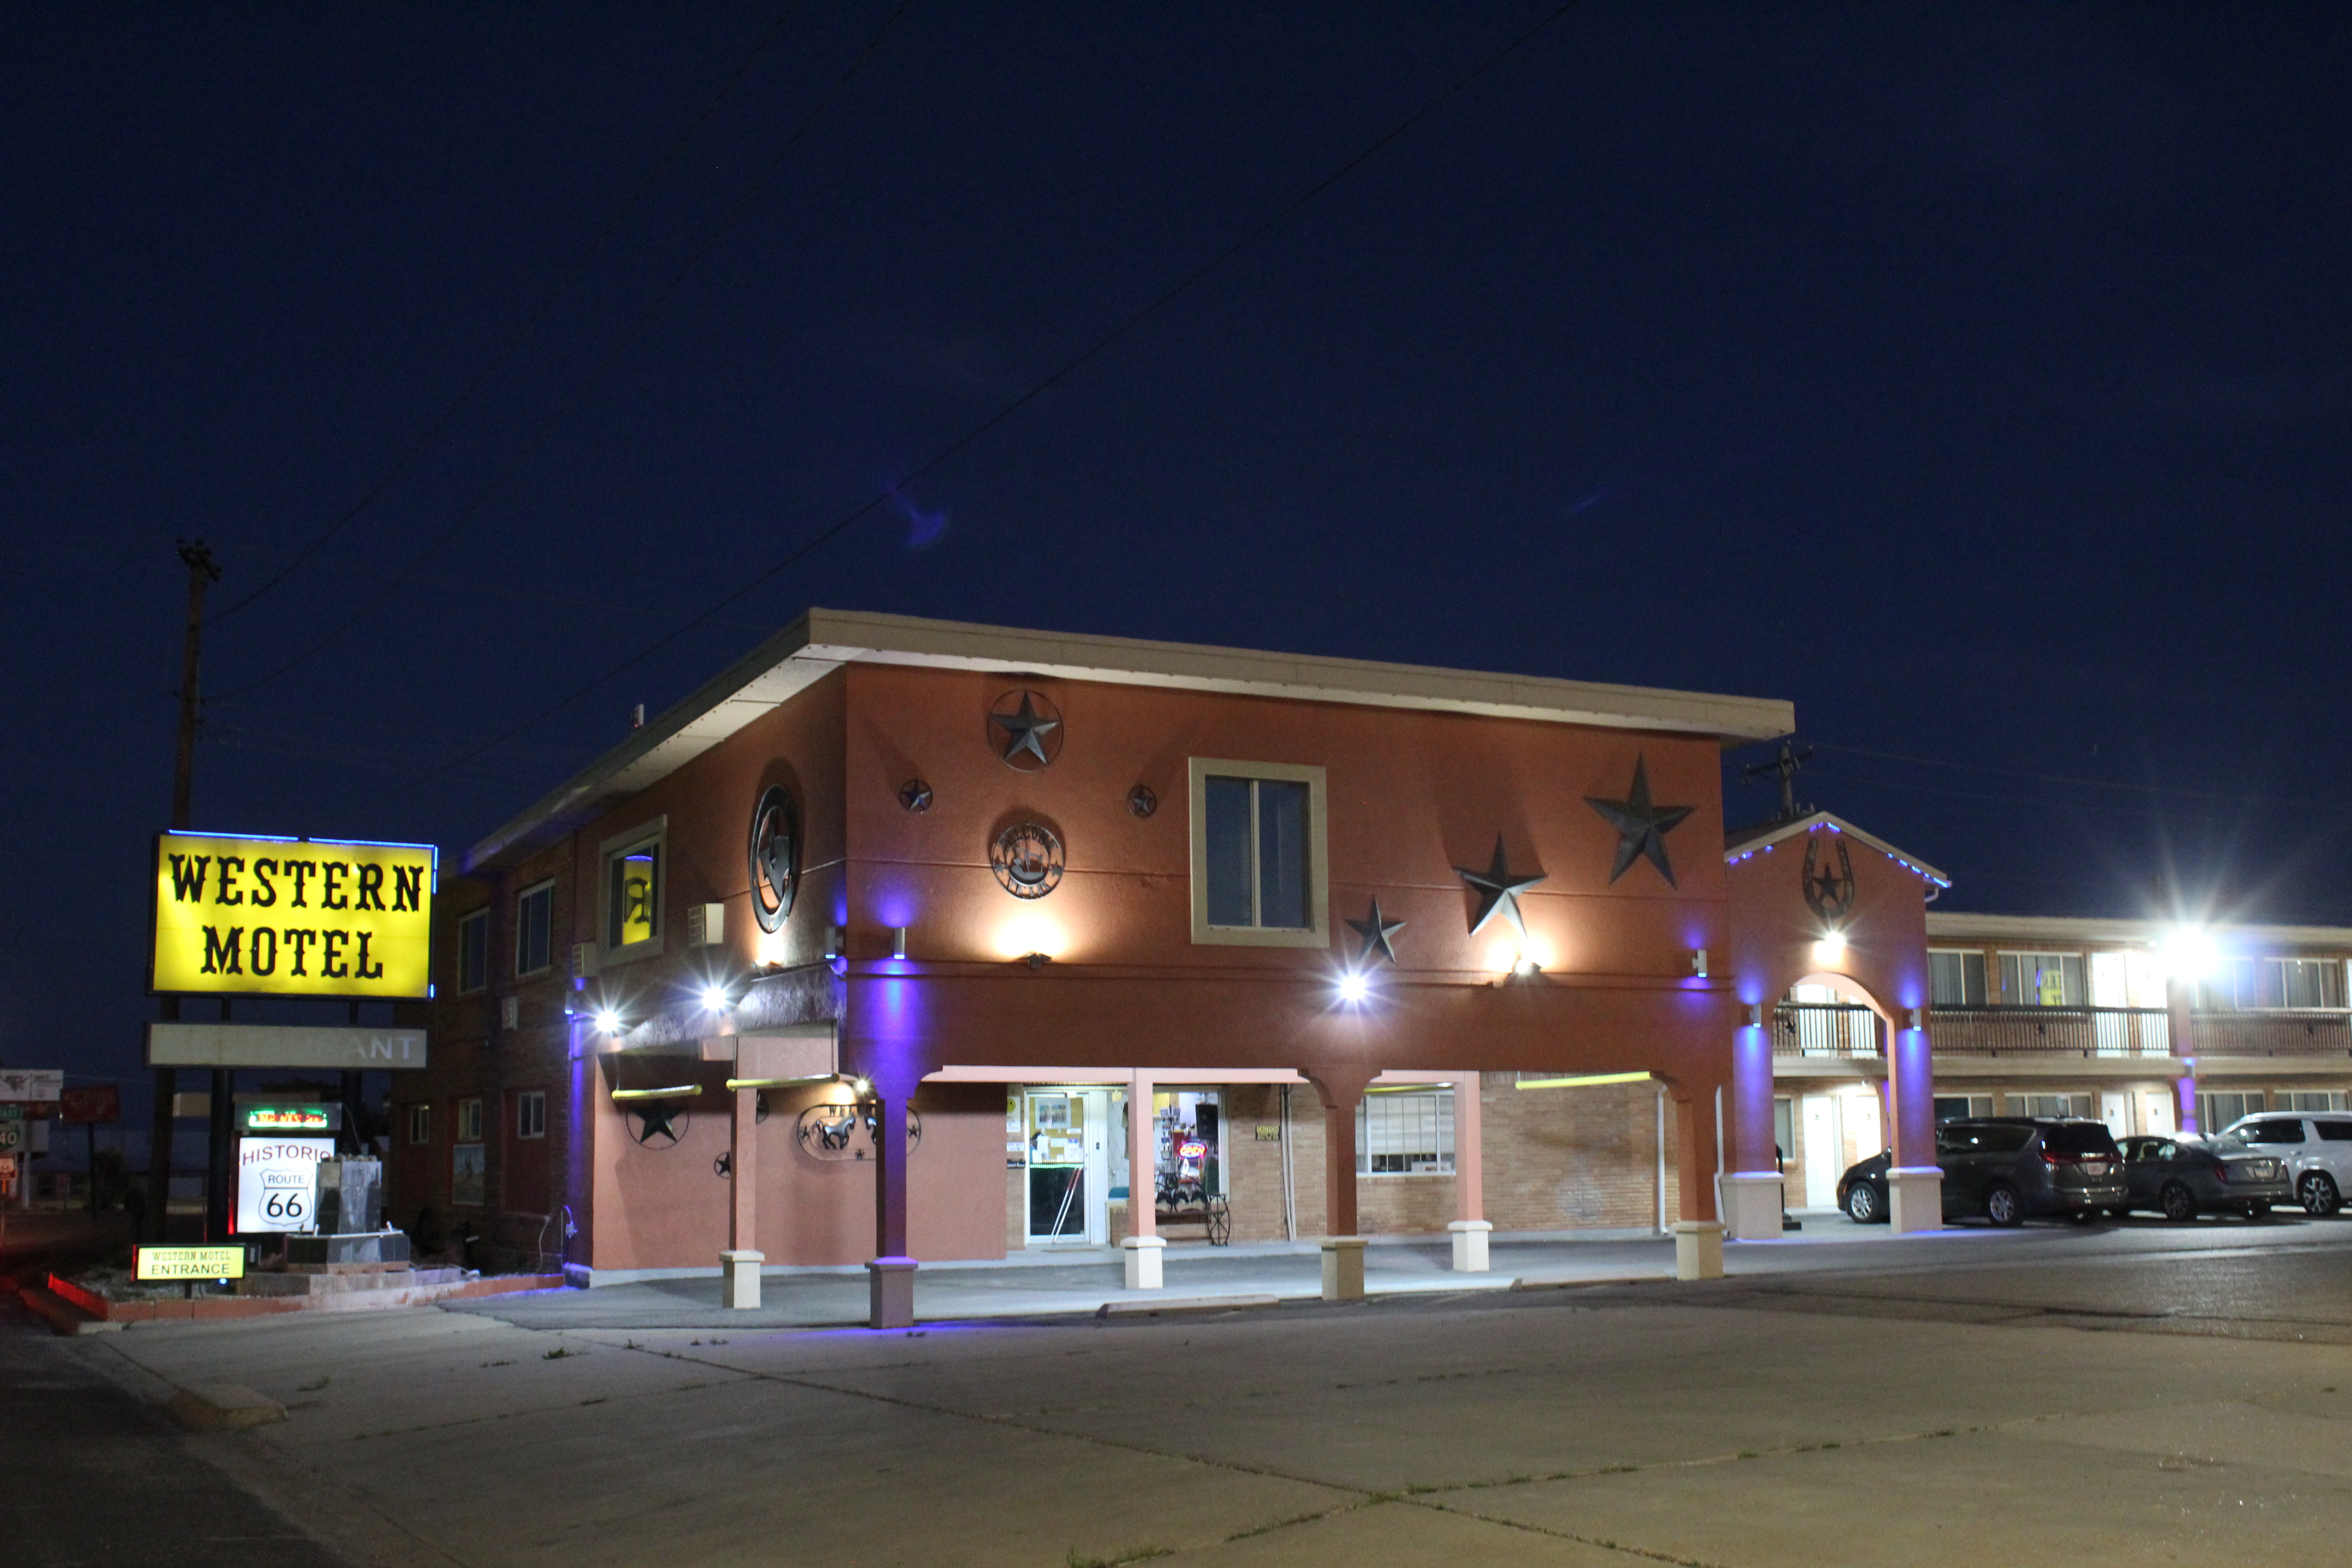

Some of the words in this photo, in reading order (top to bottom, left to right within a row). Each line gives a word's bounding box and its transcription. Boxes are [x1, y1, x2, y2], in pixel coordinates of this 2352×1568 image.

[168, 853, 424, 912] WESTERN
[200, 925, 383, 979] MOTEL
[0, 1109, 17, 1117] AST
[0, 1132, 17, 1145] 40
[1180, 1146, 1205, 1156] OPEN
[268, 1174, 305, 1184] ROUTE
[266, 1192, 303, 1218] 66
[152, 1251, 196, 1261] WESTERN
[200, 1251, 230, 1260] MOTEL
[152, 1263, 230, 1275] ENTRANCE
